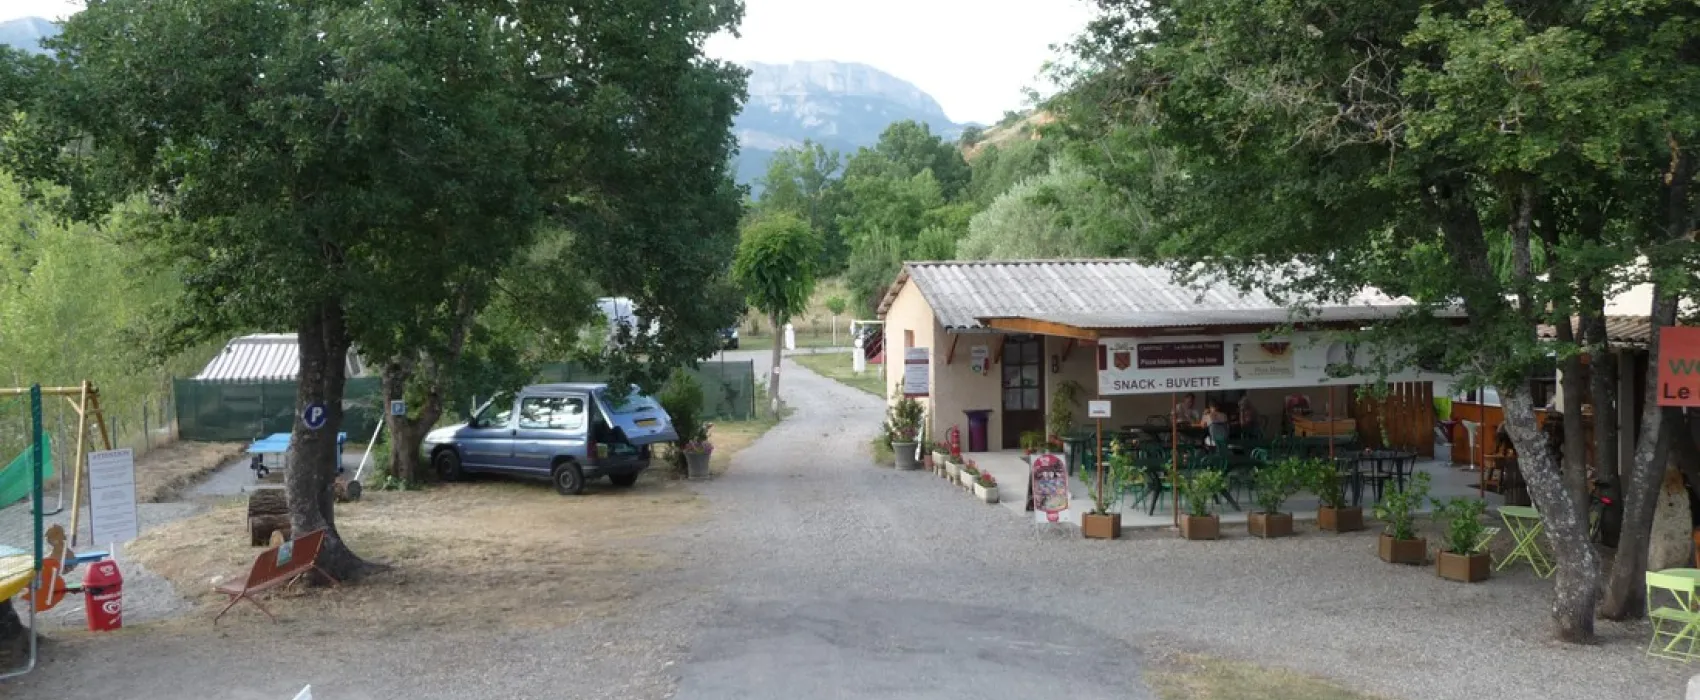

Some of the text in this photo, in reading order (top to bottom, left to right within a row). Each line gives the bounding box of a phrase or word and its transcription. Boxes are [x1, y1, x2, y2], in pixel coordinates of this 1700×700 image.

[1113, 379, 1156, 391] SNACK
[1166, 377, 1220, 388] BUVETTE
[1663, 382, 1690, 399] Le
[311, 406, 324, 422] P
